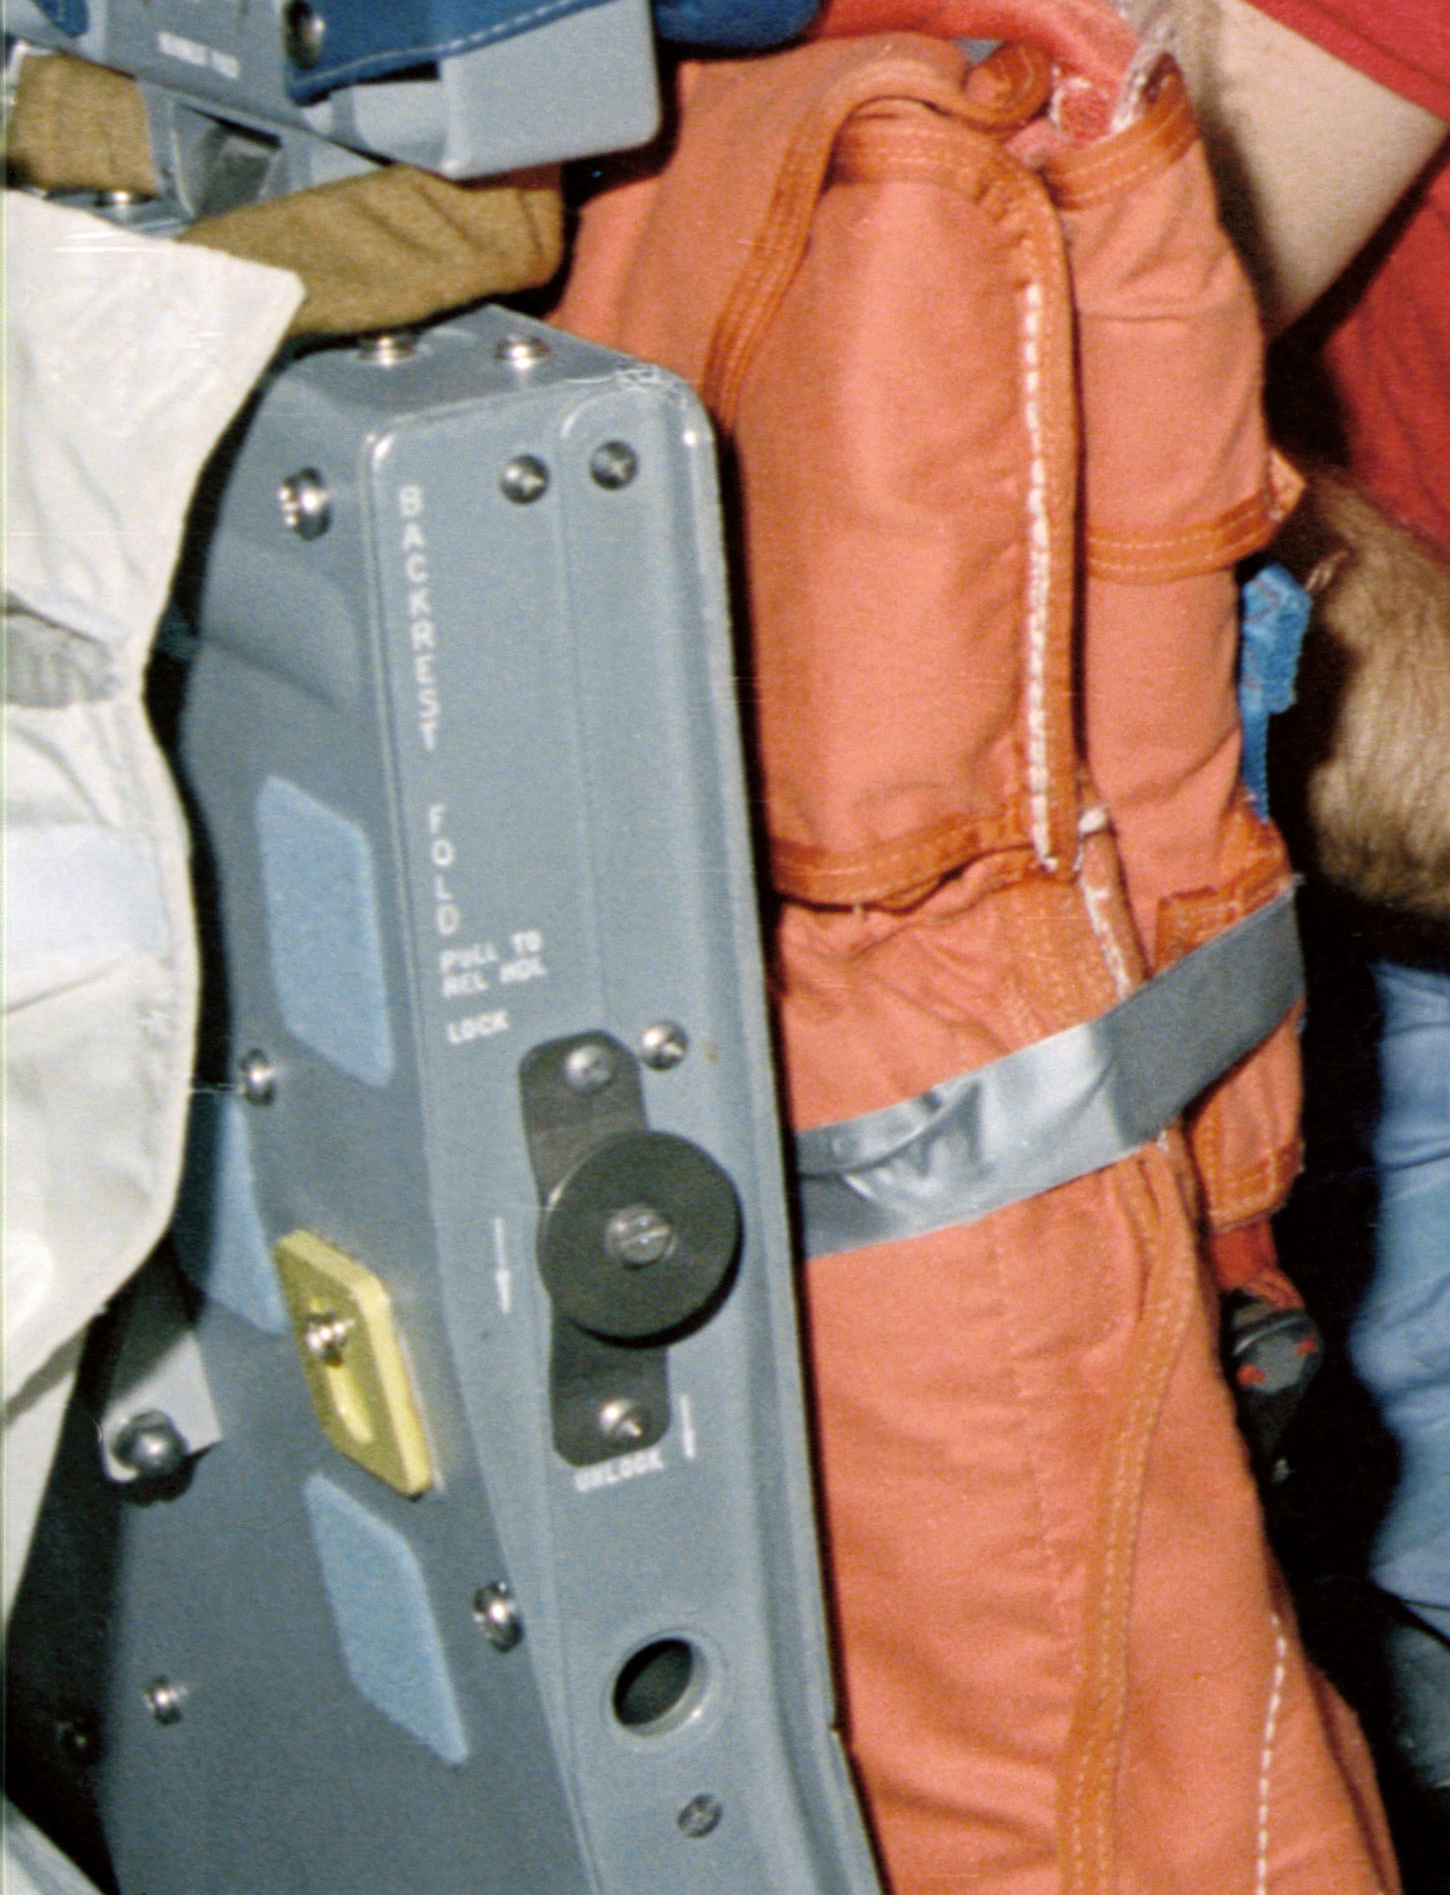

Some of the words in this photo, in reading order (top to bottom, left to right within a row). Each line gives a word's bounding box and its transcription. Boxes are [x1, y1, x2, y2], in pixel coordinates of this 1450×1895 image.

[399, 484, 442, 752] BACKREST
[428, 803, 460, 937] FOLD
[440, 942, 498, 973] PULL
[509, 929, 544, 955] TO
[441, 974, 490, 1000] REL
[446, 1009, 510, 1046] LOCK
[574, 1452, 666, 1494] UNLOCK
